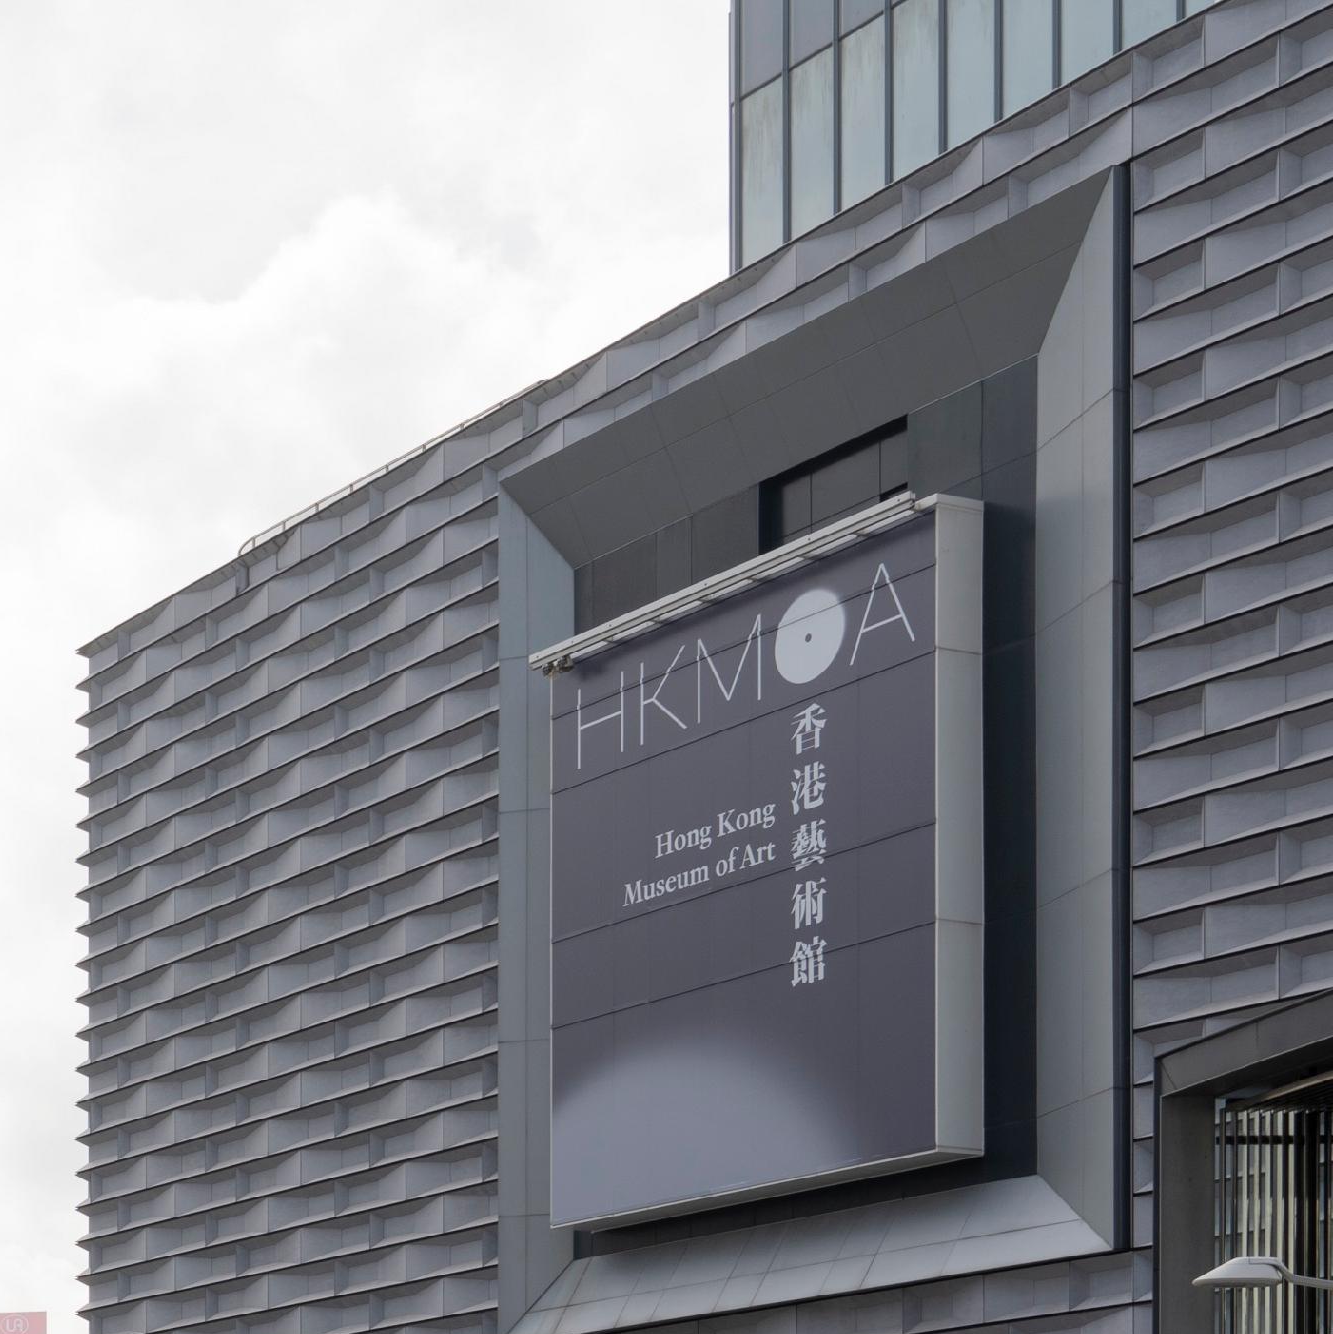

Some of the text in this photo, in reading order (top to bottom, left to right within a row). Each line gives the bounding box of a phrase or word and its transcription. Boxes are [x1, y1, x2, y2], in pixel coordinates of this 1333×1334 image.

[576, 562, 916, 771] HKMOA
[622, 842, 777, 907] Museum of Art
[654, 803, 776, 859] Hong Kong
[789, 702, 827, 988] 香港藝術館
